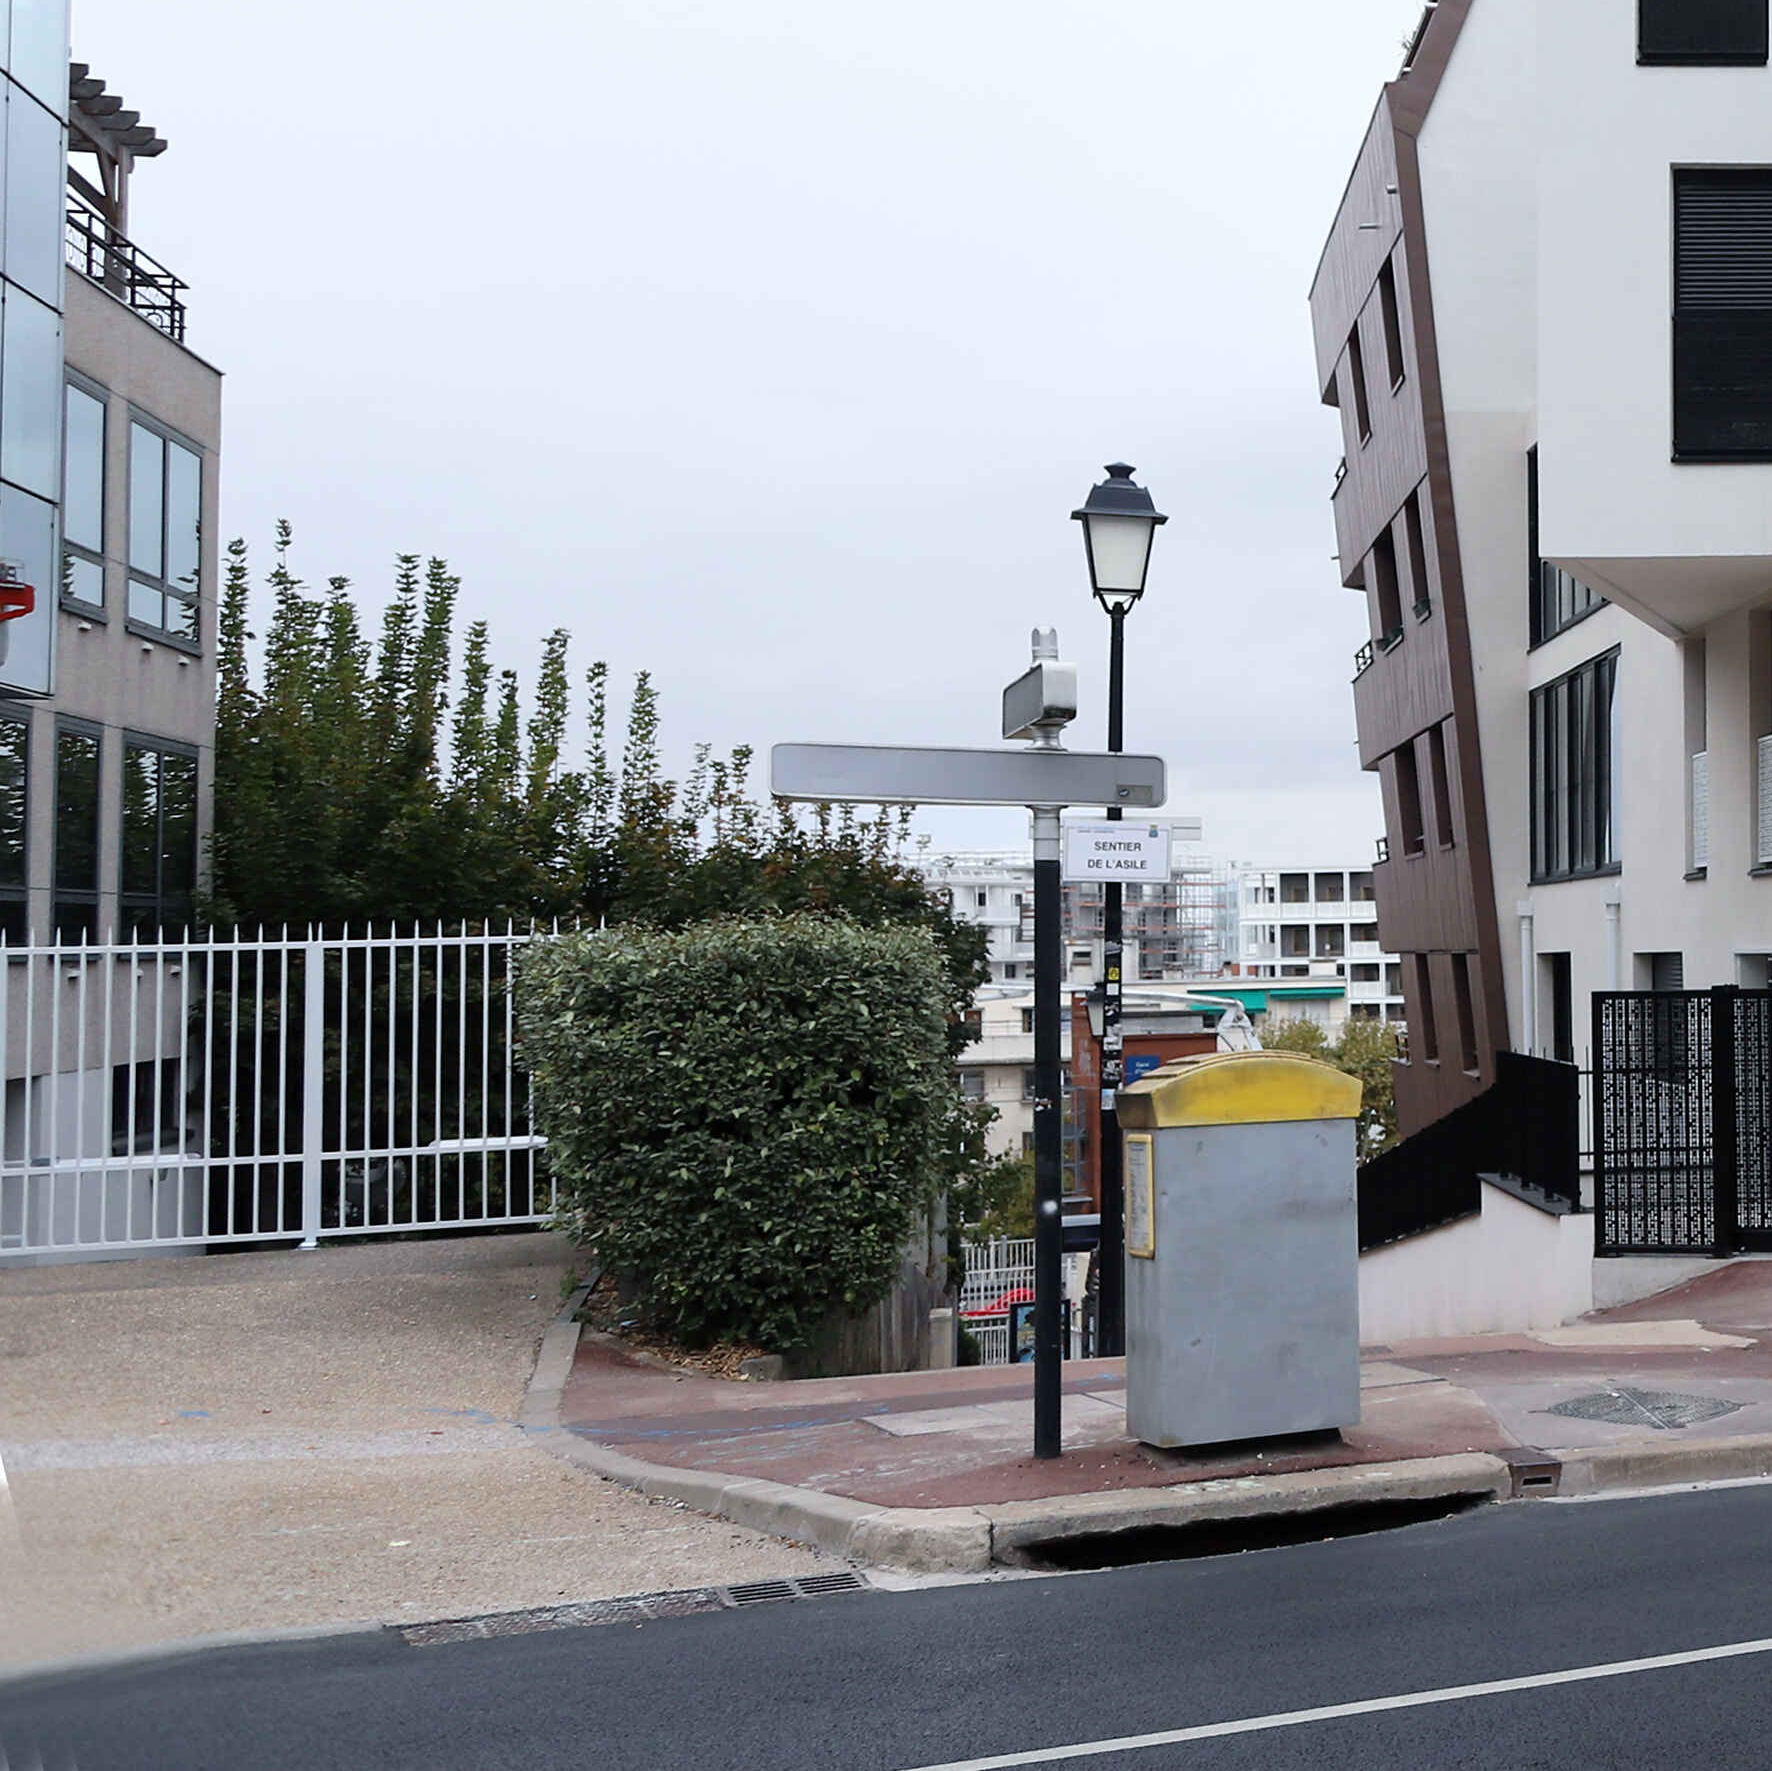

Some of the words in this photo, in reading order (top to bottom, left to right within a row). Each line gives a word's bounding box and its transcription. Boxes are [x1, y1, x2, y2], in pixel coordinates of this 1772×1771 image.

[1094, 841, 1142, 852] SENTIER
[1087, 859, 1102, 869] DE
[1105, 859, 1147, 869] L'ASILE
